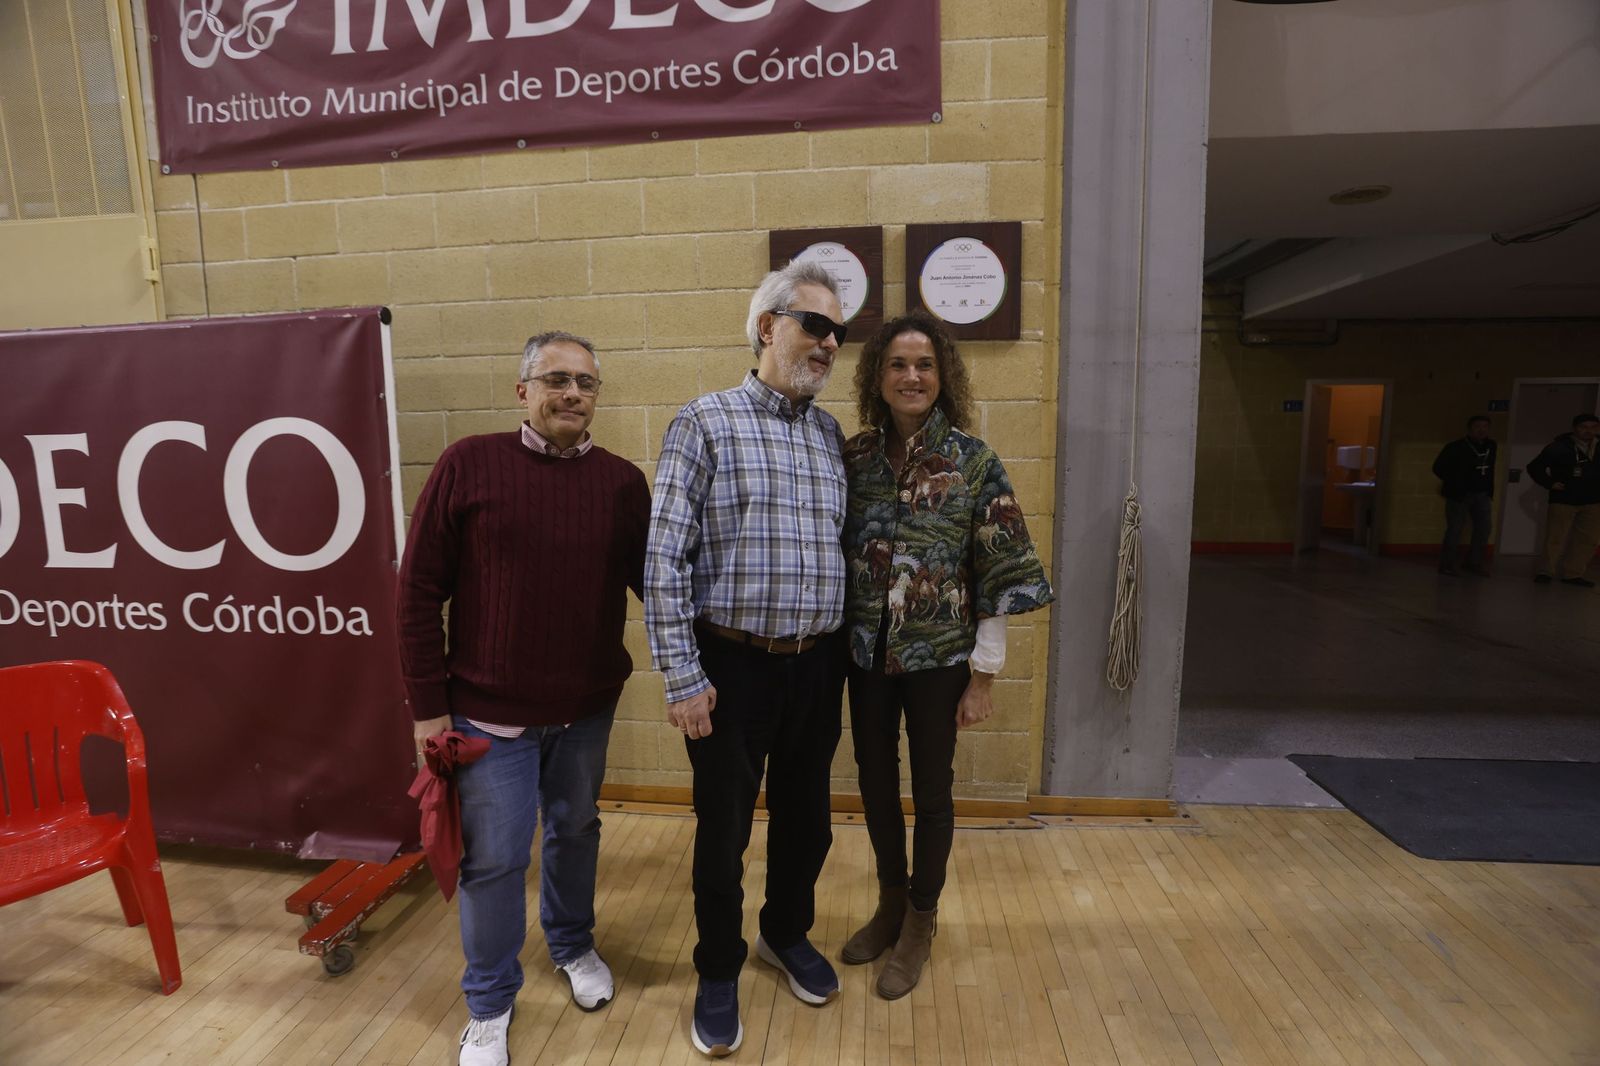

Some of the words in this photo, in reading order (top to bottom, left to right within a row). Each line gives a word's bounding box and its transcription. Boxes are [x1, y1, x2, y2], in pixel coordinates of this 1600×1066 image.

[187, 90, 311, 125] Instituto
[322, 74, 488, 117] Municipal
[499, 70, 542, 101] de
[555, 59, 721, 103] Deportes
[733, 42, 898, 84] Córdoba
[0, 416, 366, 571] ECO
[0, 589, 167, 637] Deportes
[182, 593, 374, 636] Córdoba
